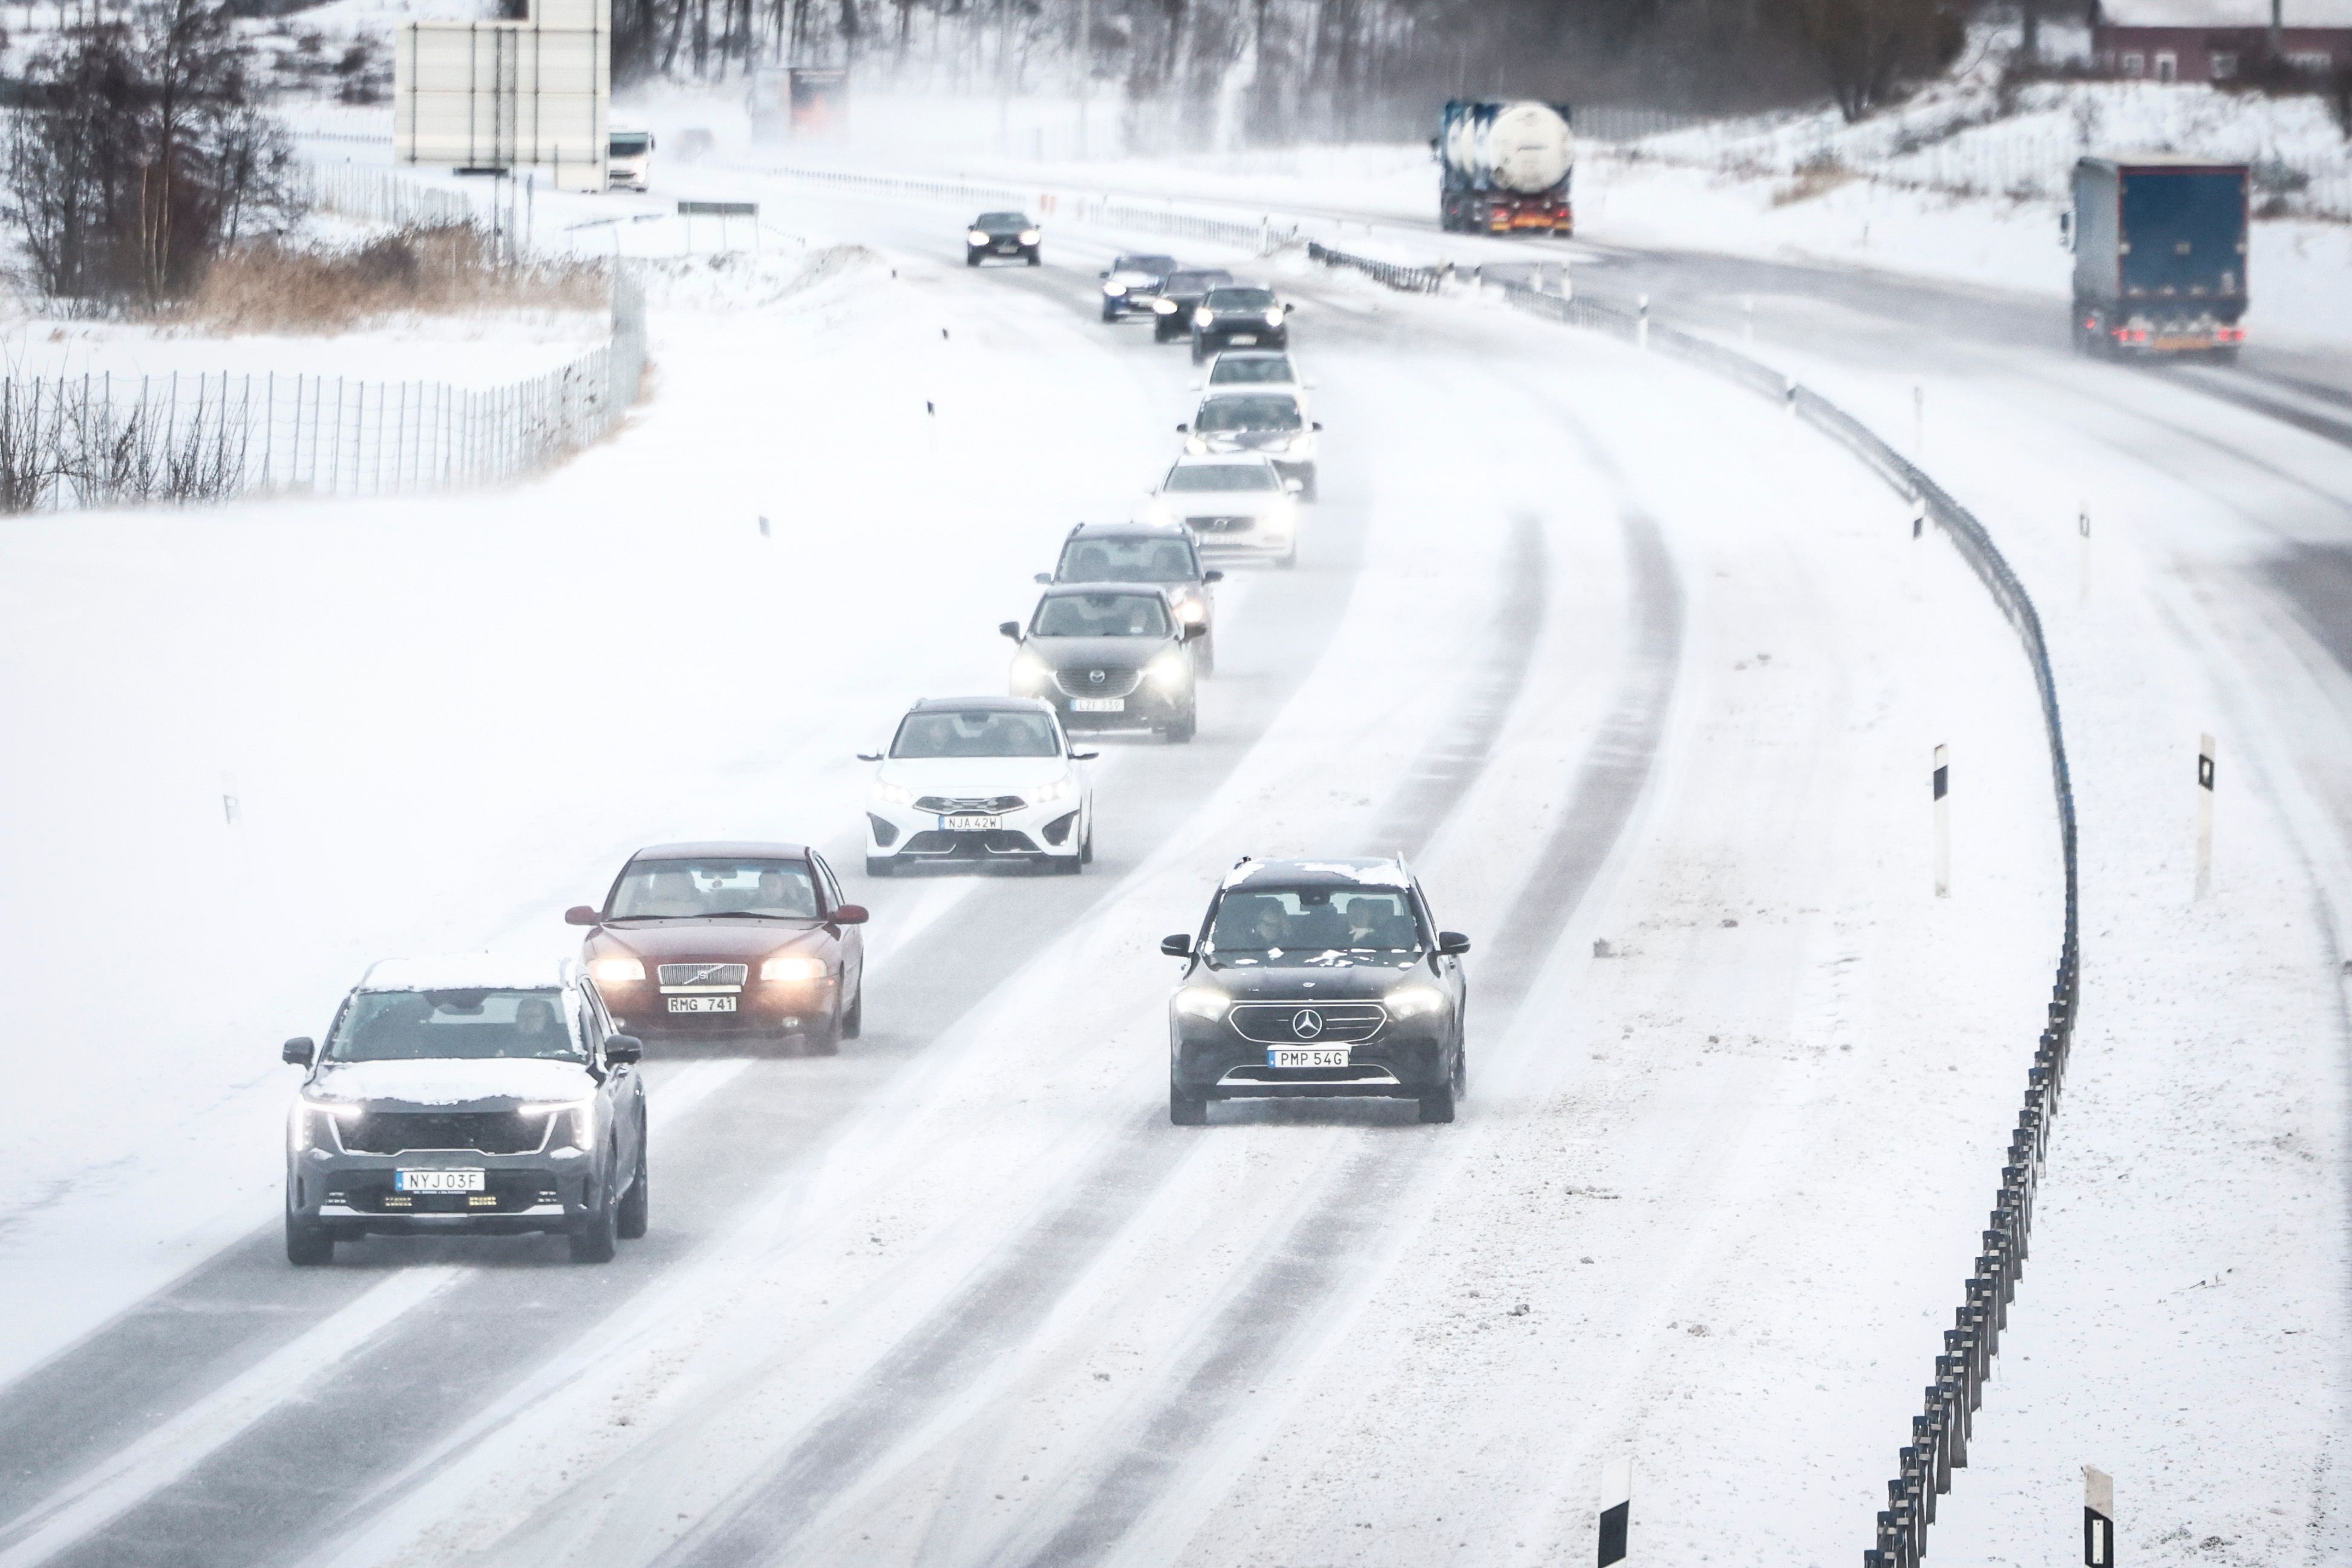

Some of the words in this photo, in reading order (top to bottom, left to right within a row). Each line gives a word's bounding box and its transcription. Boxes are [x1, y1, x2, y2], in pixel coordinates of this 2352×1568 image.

[949, 817, 970, 828] NJA
[975, 817, 996, 828] 42W
[670, 999, 698, 1011] RMG
[708, 998, 733, 1011] 741
[1281, 1053, 1308, 1066] PMP
[1314, 1052, 1342, 1066] 54G
[410, 1174, 440, 1188] NYJ
[446, 1174, 477, 1188] 03F
